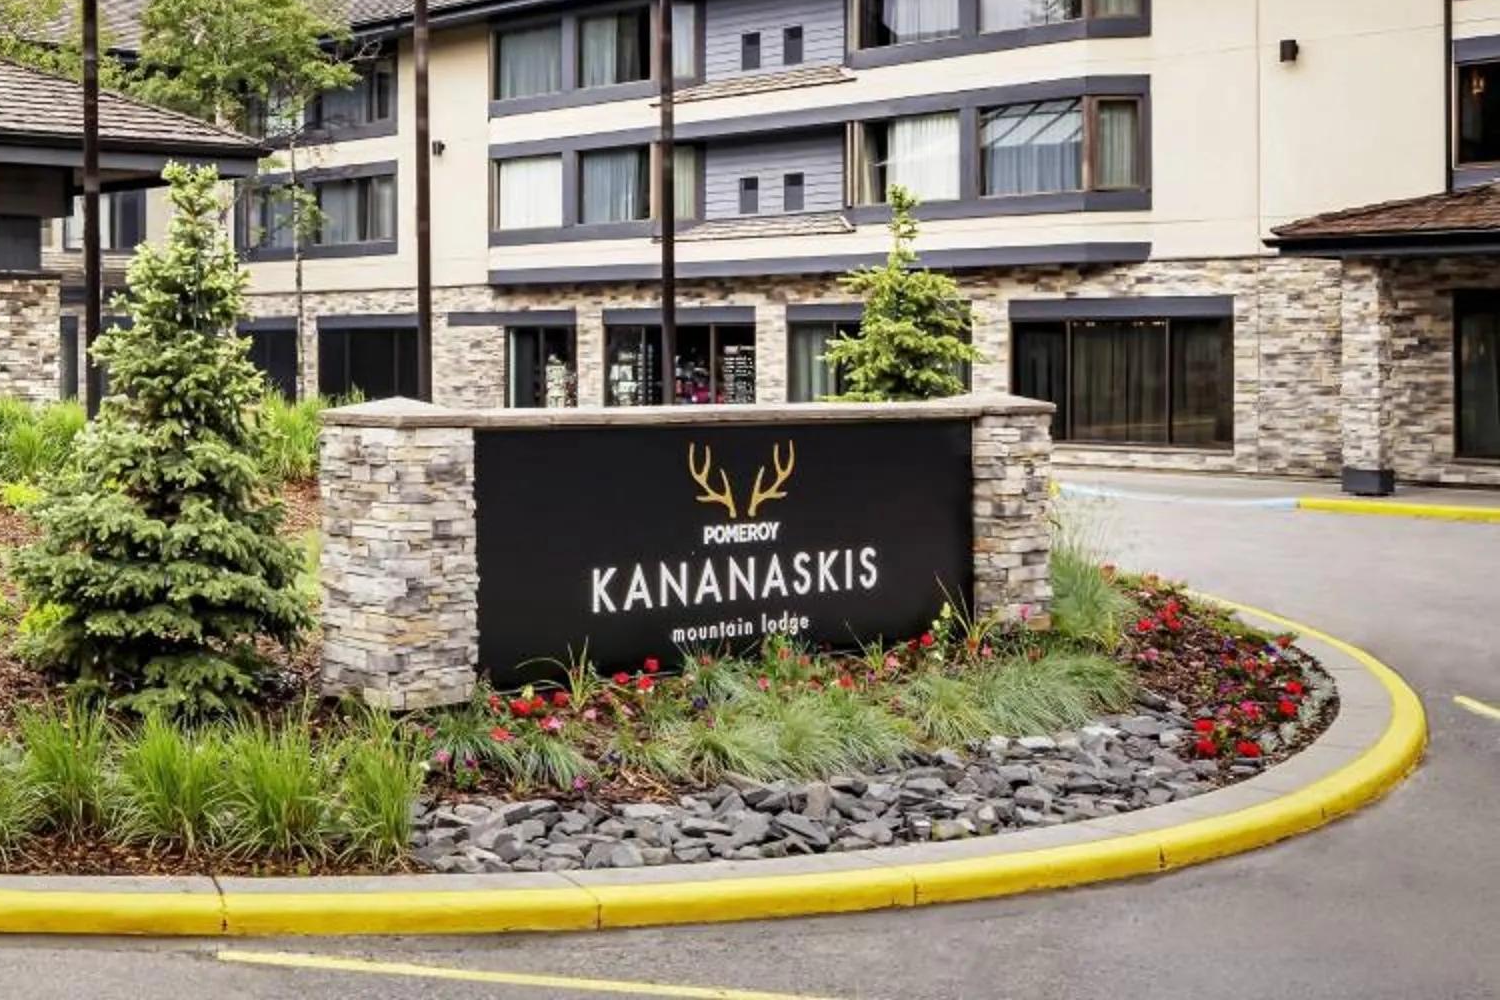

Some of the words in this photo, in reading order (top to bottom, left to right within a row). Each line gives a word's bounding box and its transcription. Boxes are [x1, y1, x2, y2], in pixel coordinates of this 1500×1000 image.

[703, 521, 780, 545] POMEROY
[592, 546, 878, 613] KANANASKIS
[672, 617, 753, 643] mountain
[761, 610, 809, 635] lodge
